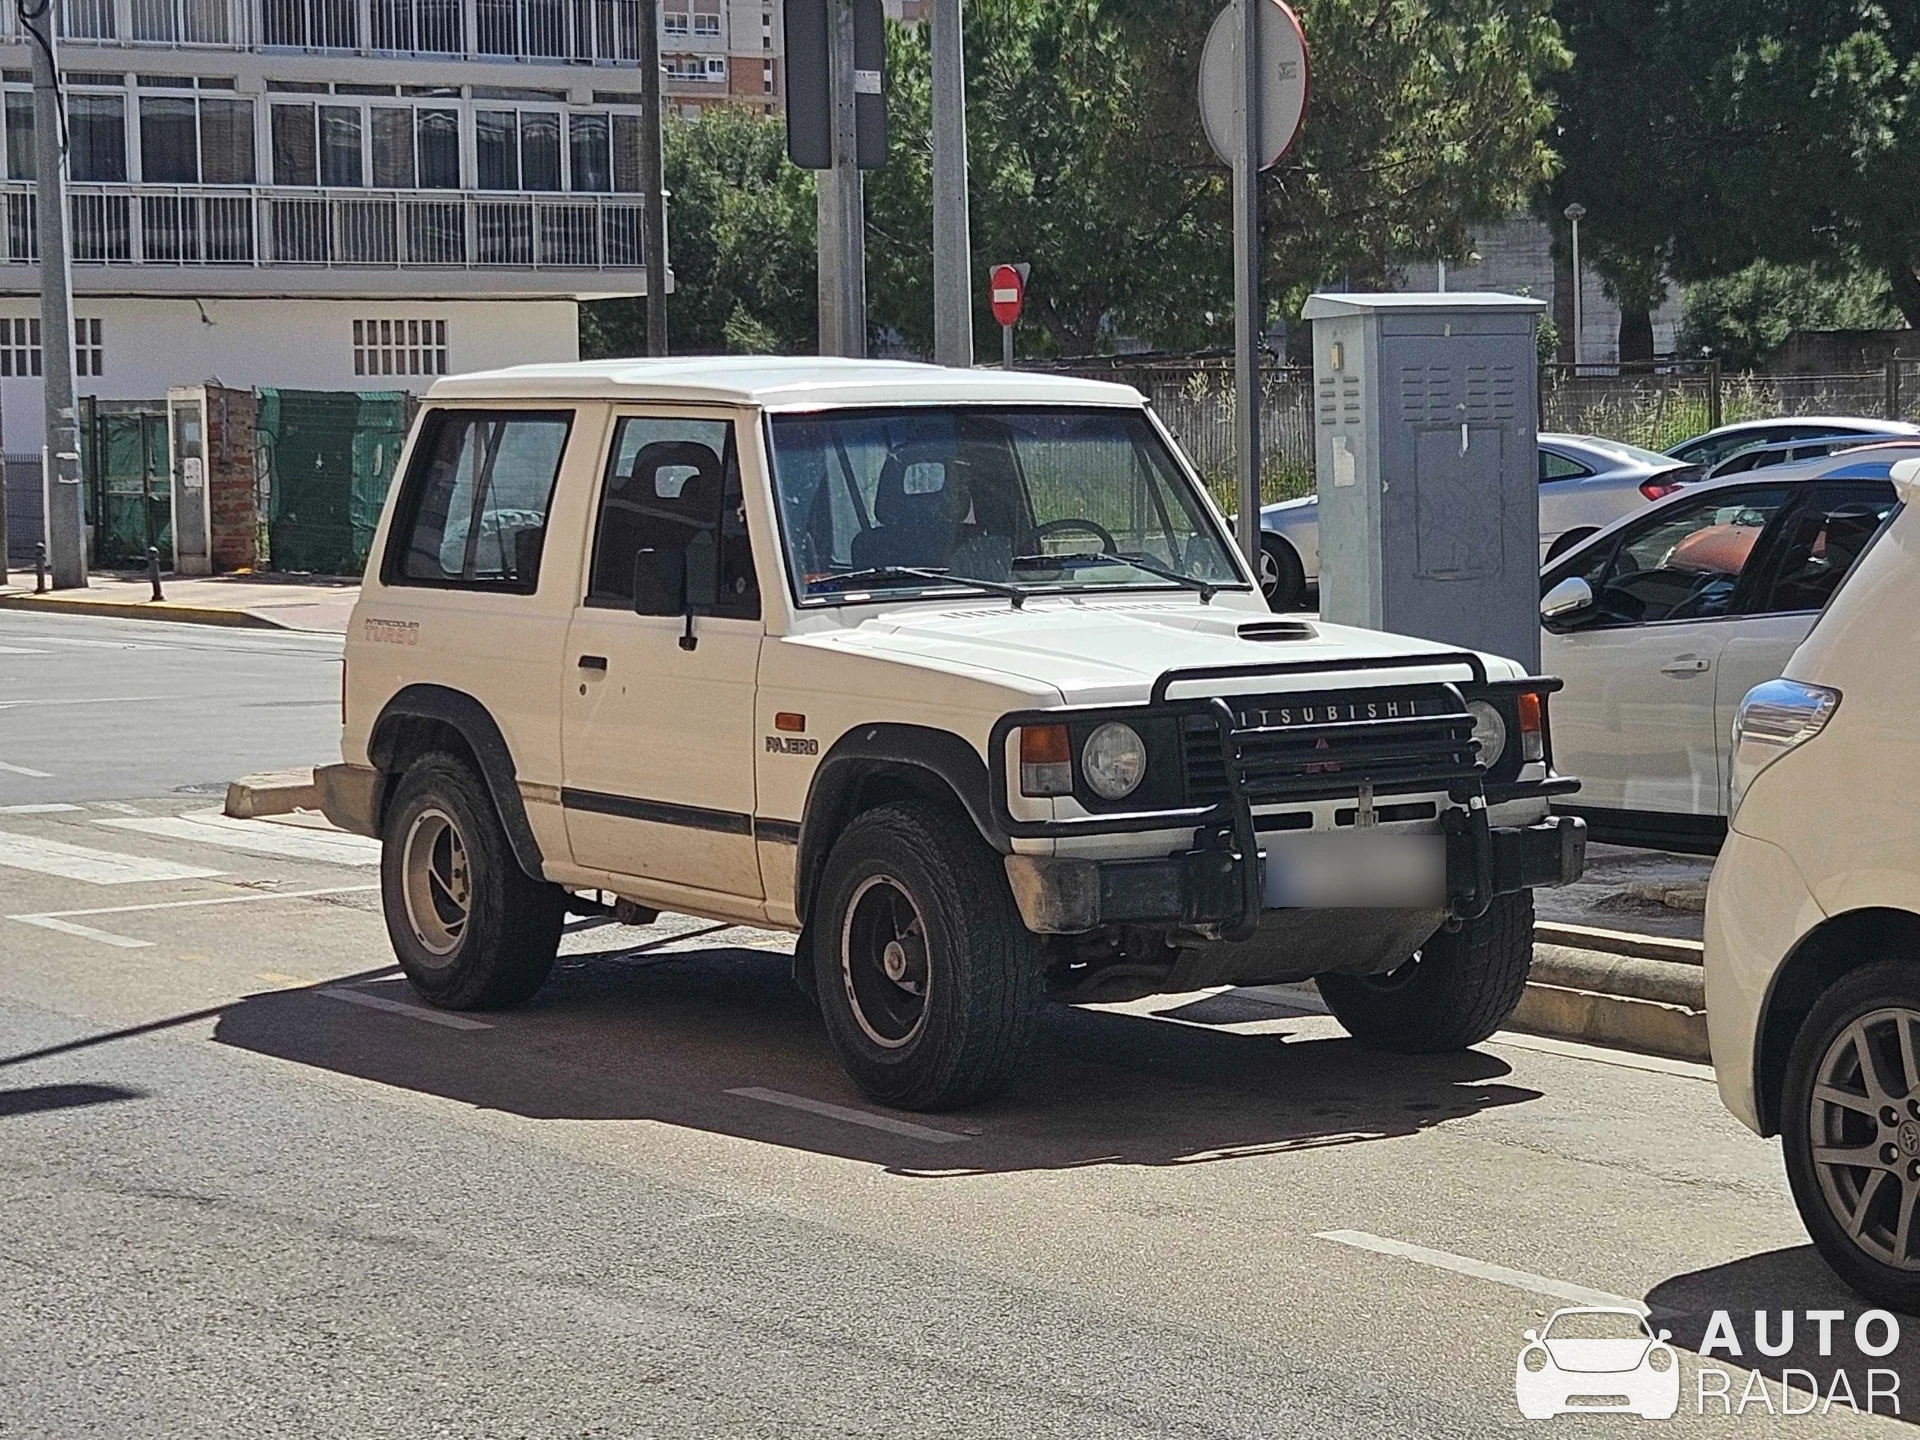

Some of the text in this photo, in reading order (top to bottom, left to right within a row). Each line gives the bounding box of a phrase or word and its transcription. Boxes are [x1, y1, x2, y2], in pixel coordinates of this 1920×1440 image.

[366, 618, 419, 628] INTERCOOLER
[364, 625, 419, 645] TURBO
[1215, 701, 1416, 728] ITSUBISHI
[765, 736, 818, 755] PAJERO
